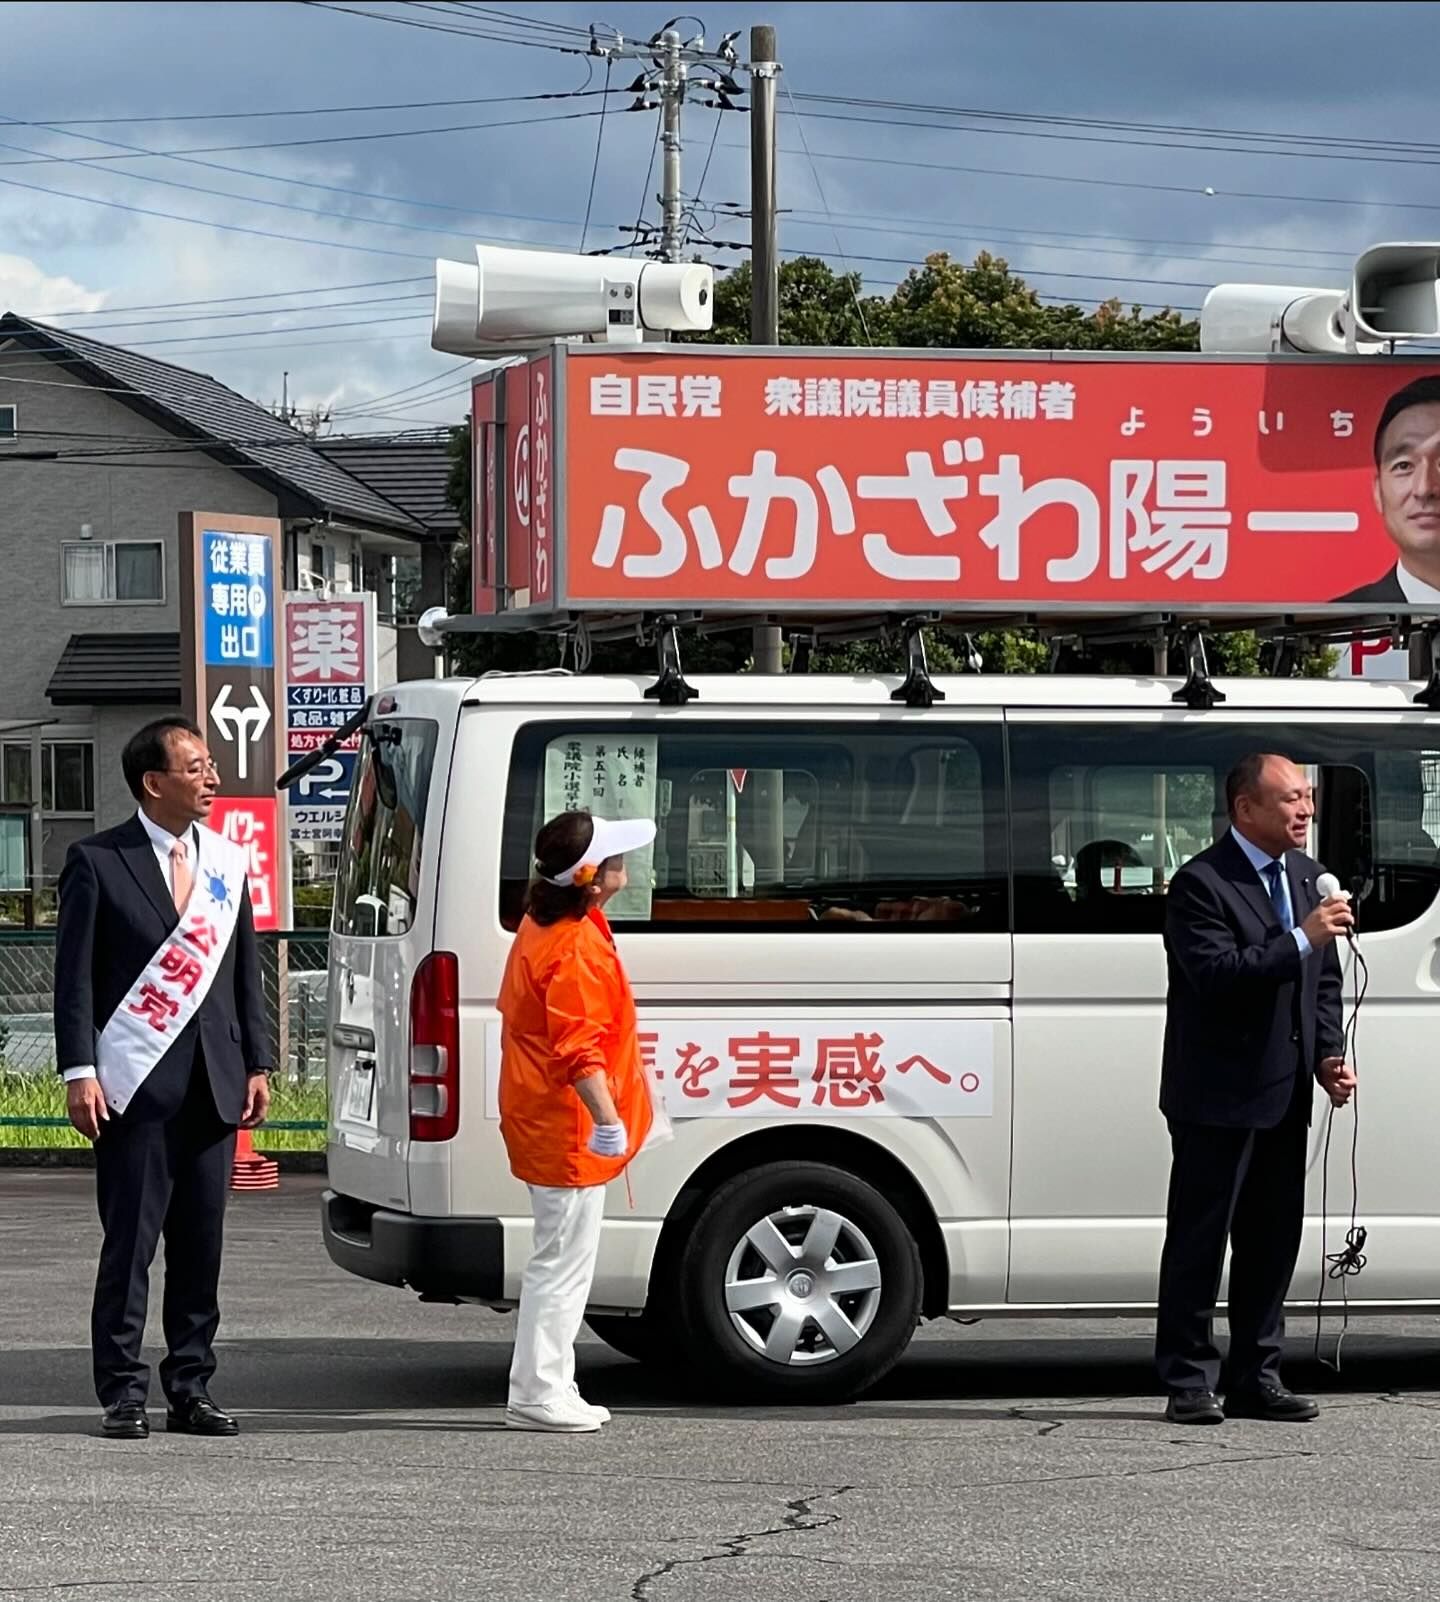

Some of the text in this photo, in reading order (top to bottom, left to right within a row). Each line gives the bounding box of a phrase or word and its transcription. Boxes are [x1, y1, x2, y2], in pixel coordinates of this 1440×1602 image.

[590, 374, 1076, 420] 自民党 衆議院議員候補者
[1120, 407, 1354, 437] よういち
[535, 371, 548, 593] ふかざわ
[592, 436, 1359, 583] ふかざわ陽一
[210, 539, 265, 576] 従業員
[221, 624, 259, 658] 出口
[290, 608, 360, 679] 薬
[291, 734, 361, 749] 処方せ付
[593, 745, 606, 797] 第五十回
[617, 746, 629, 786] 氏名
[127, 915, 218, 1033] 公明党
